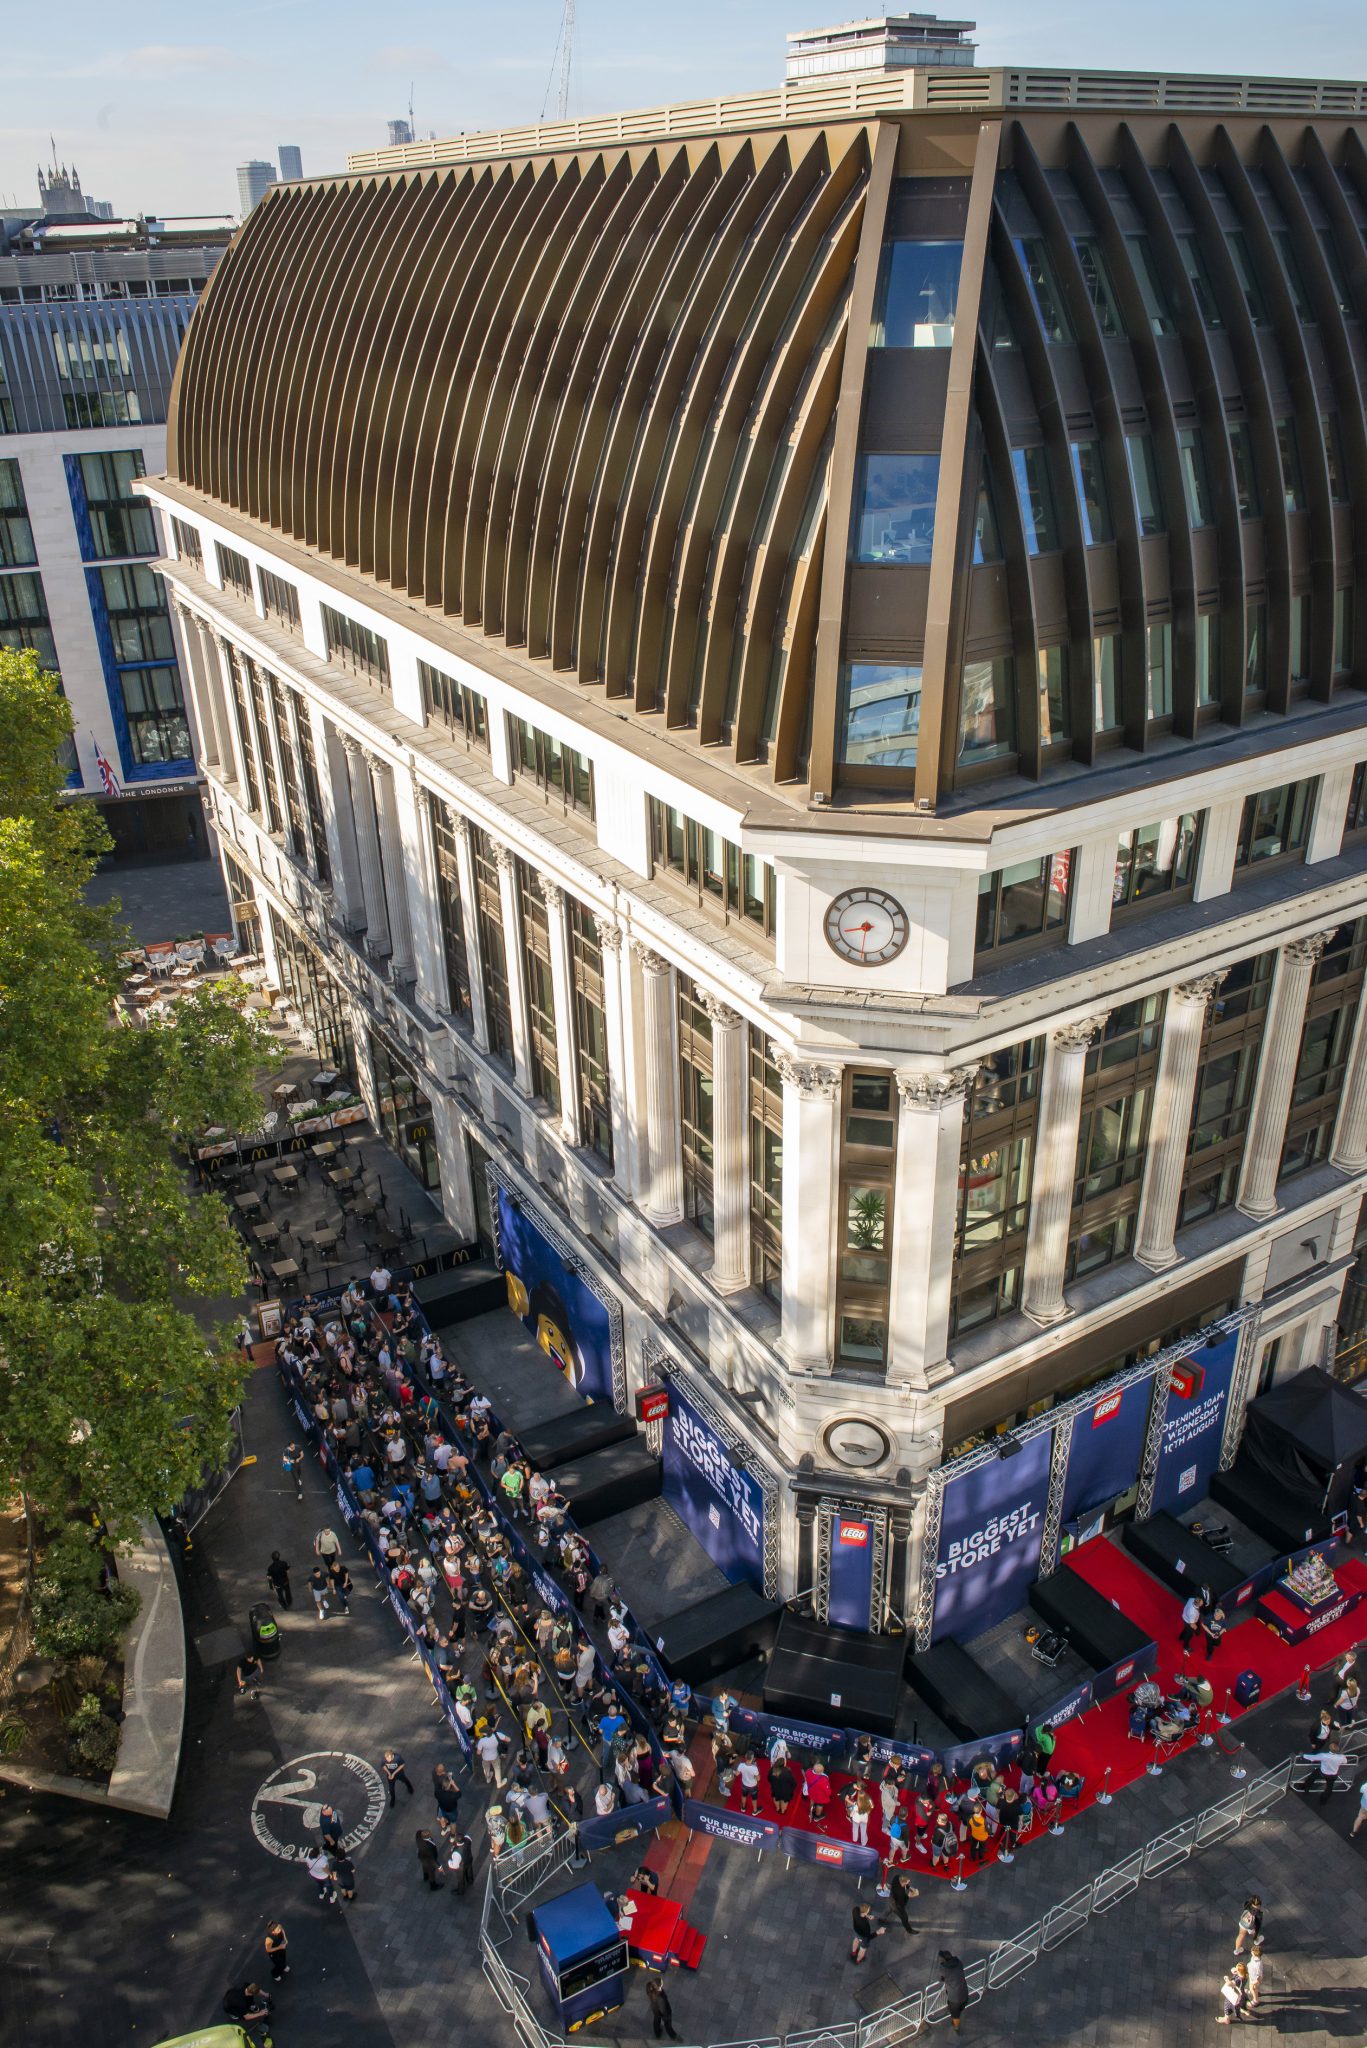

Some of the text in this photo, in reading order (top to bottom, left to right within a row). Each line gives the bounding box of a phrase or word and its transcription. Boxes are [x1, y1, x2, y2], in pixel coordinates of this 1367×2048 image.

[141, 786, 184, 796] LONDONER
[648, 1404, 666, 1417] LEGO
[1095, 1396, 1120, 1418] LEGO
[1163, 1405, 1201, 1433] OPENING
[1168, 1403, 1220, 1441] WEDNESDAY
[1187, 1412, 1220, 1440] AUGUST
[678, 1405, 752, 1502] BIGGEST
[672, 1416, 761, 1537] STORE YET
[949, 1502, 1031, 1559] BIGGEST
[987, 1517, 998, 1525] OUR
[842, 1527, 867, 1540] LEGO
[936, 1512, 1040, 1579] STORE YET
[770, 1726, 790, 1735] OUR
[793, 1730, 831, 1744] BIGGEST
[777, 1733, 823, 1748] STORE YET
[700, 1815, 720, 1827] OUR
[722, 1823, 763, 1838] BIGGEST
[705, 1823, 735, 1838] STORE
[738, 1834, 755, 1844] YET
[817, 1846, 842, 1858] LEGO
